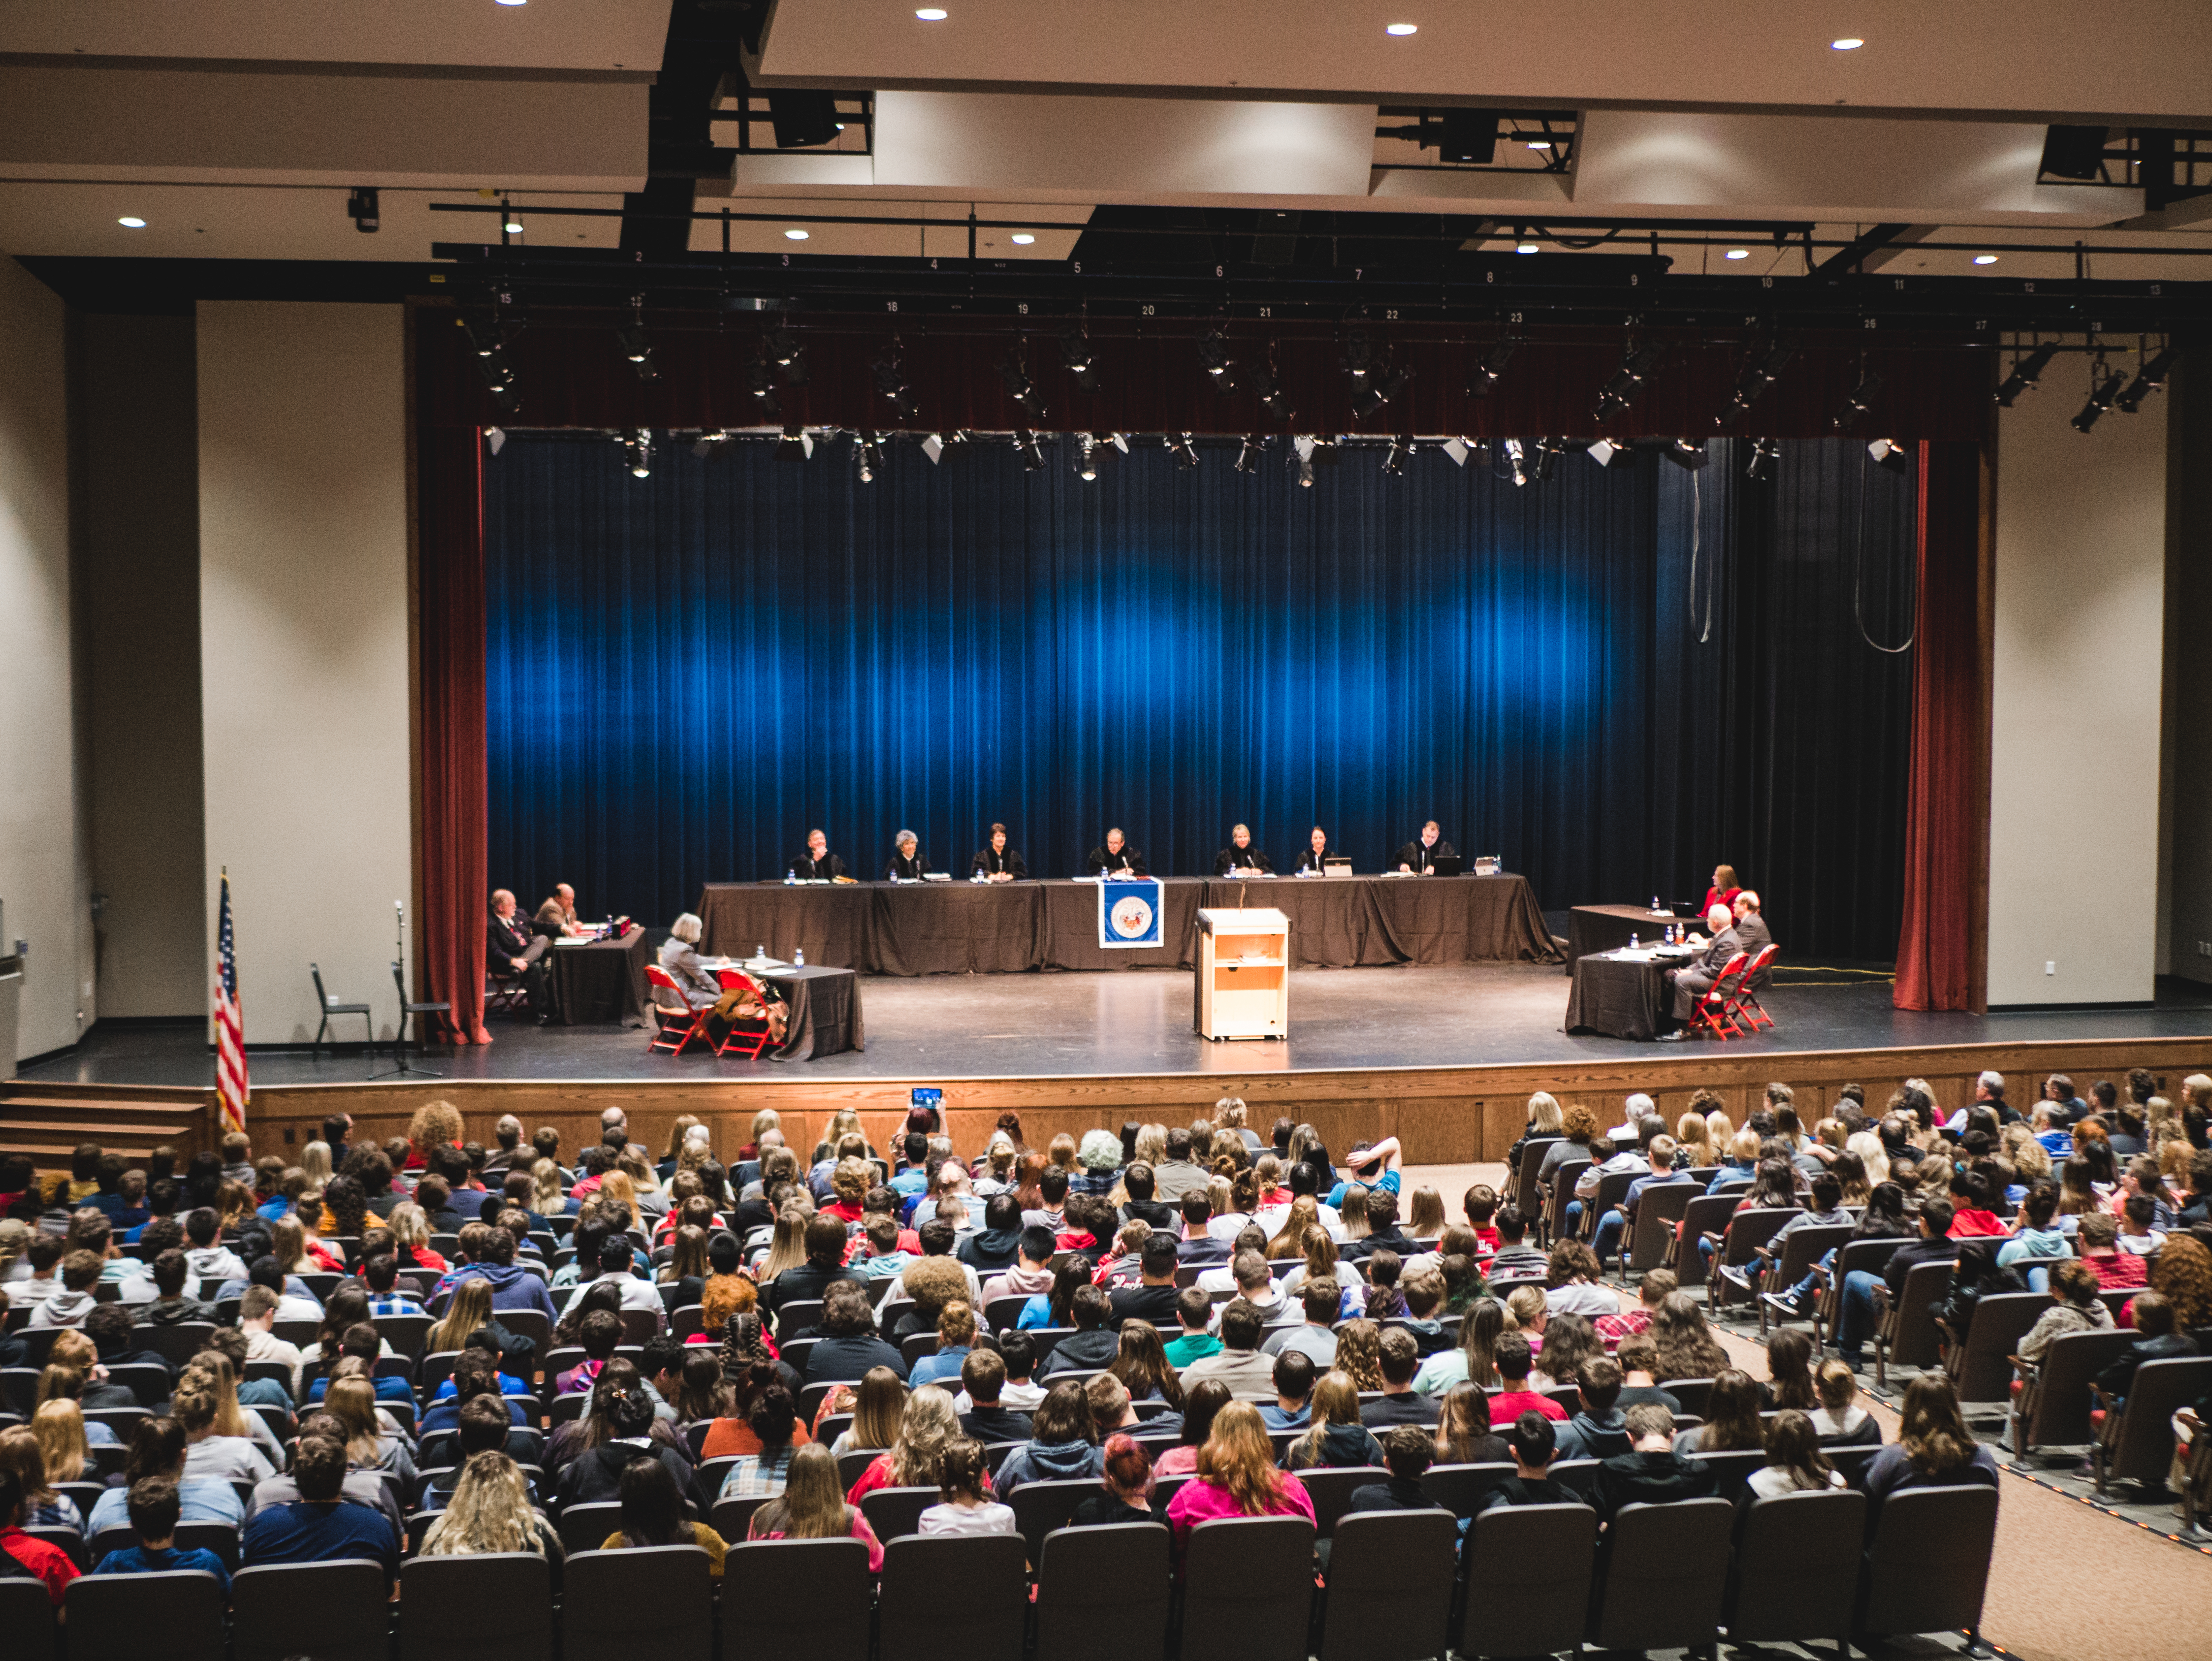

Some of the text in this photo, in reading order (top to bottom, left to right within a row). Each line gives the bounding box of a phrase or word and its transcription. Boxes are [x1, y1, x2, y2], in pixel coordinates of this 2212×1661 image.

[636, 251, 642, 262] 2
[782, 255, 789, 266] 3
[930, 259, 938, 270] 4
[1074, 261, 1081, 273] 5
[1216, 265, 1223, 277] 6
[1355, 268, 1362, 280] 7
[1487, 271, 1493, 283] 8
[1631, 274, 1638, 286] 9
[1762, 277, 1773, 288] 10
[1894, 279, 1904, 290] 11
[500, 293, 512, 304] 15
[886, 301, 898, 312] 18
[1018, 304, 1028, 314] 19
[1142, 305, 1154, 316] 20
[1259, 307, 1270, 317] 21
[1386, 310, 1398, 319] 22
[1511, 312, 1522, 322] 23
[1976, 320, 1987, 330] 27
